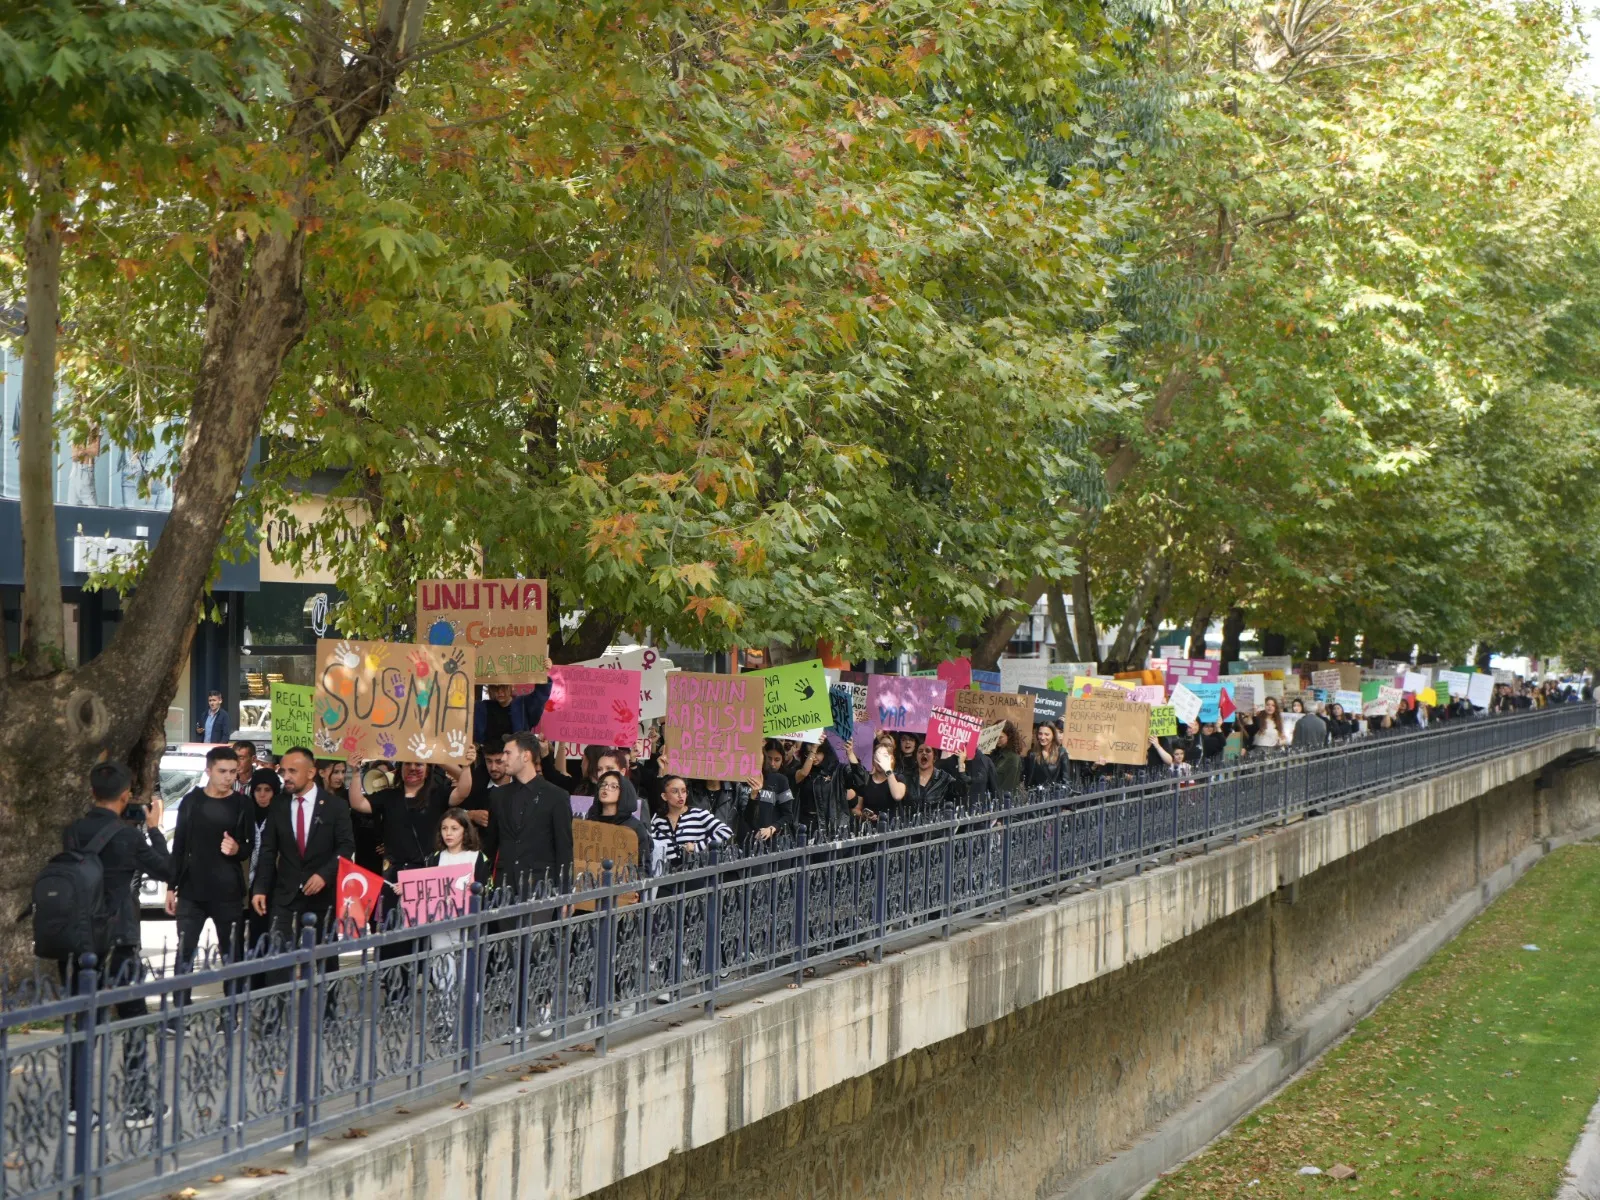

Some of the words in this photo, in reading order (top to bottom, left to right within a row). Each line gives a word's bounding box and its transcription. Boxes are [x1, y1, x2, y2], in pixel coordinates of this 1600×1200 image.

[422, 583, 542, 611] UNUTMA
[275, 691, 304, 708] REGL
[320, 663, 469, 737] SUSMA
[669, 675, 746, 704] KADININ
[763, 690, 779, 704] GI
[1071, 700, 1096, 711] GECE
[667, 703, 755, 734] KABUSU
[878, 706, 907, 728] VAR
[1068, 722, 1083, 733] BU
